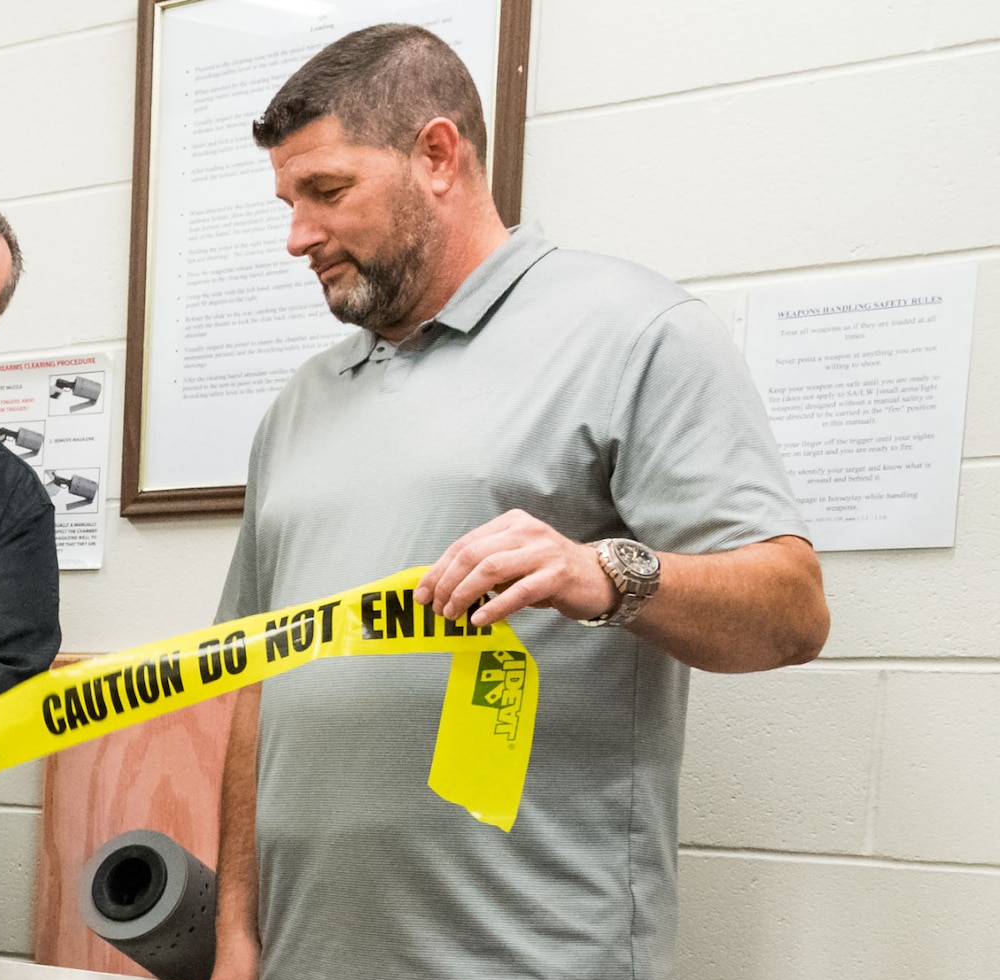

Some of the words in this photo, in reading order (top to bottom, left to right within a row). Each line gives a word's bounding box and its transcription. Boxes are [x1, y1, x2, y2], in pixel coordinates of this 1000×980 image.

[778, 309, 821, 319] WEAPONS
[823, 303, 873, 313] HANDLING
[874, 299, 908, 308] SAFETY
[911, 296, 943, 304] RULES
[24, 361, 55, 370] CLEARING
[57, 357, 96, 366] PROCEDURE
[42, 650, 184, 735] CAUTION
[198, 630, 247, 684] DO
[265, 600, 341, 663] NOT
